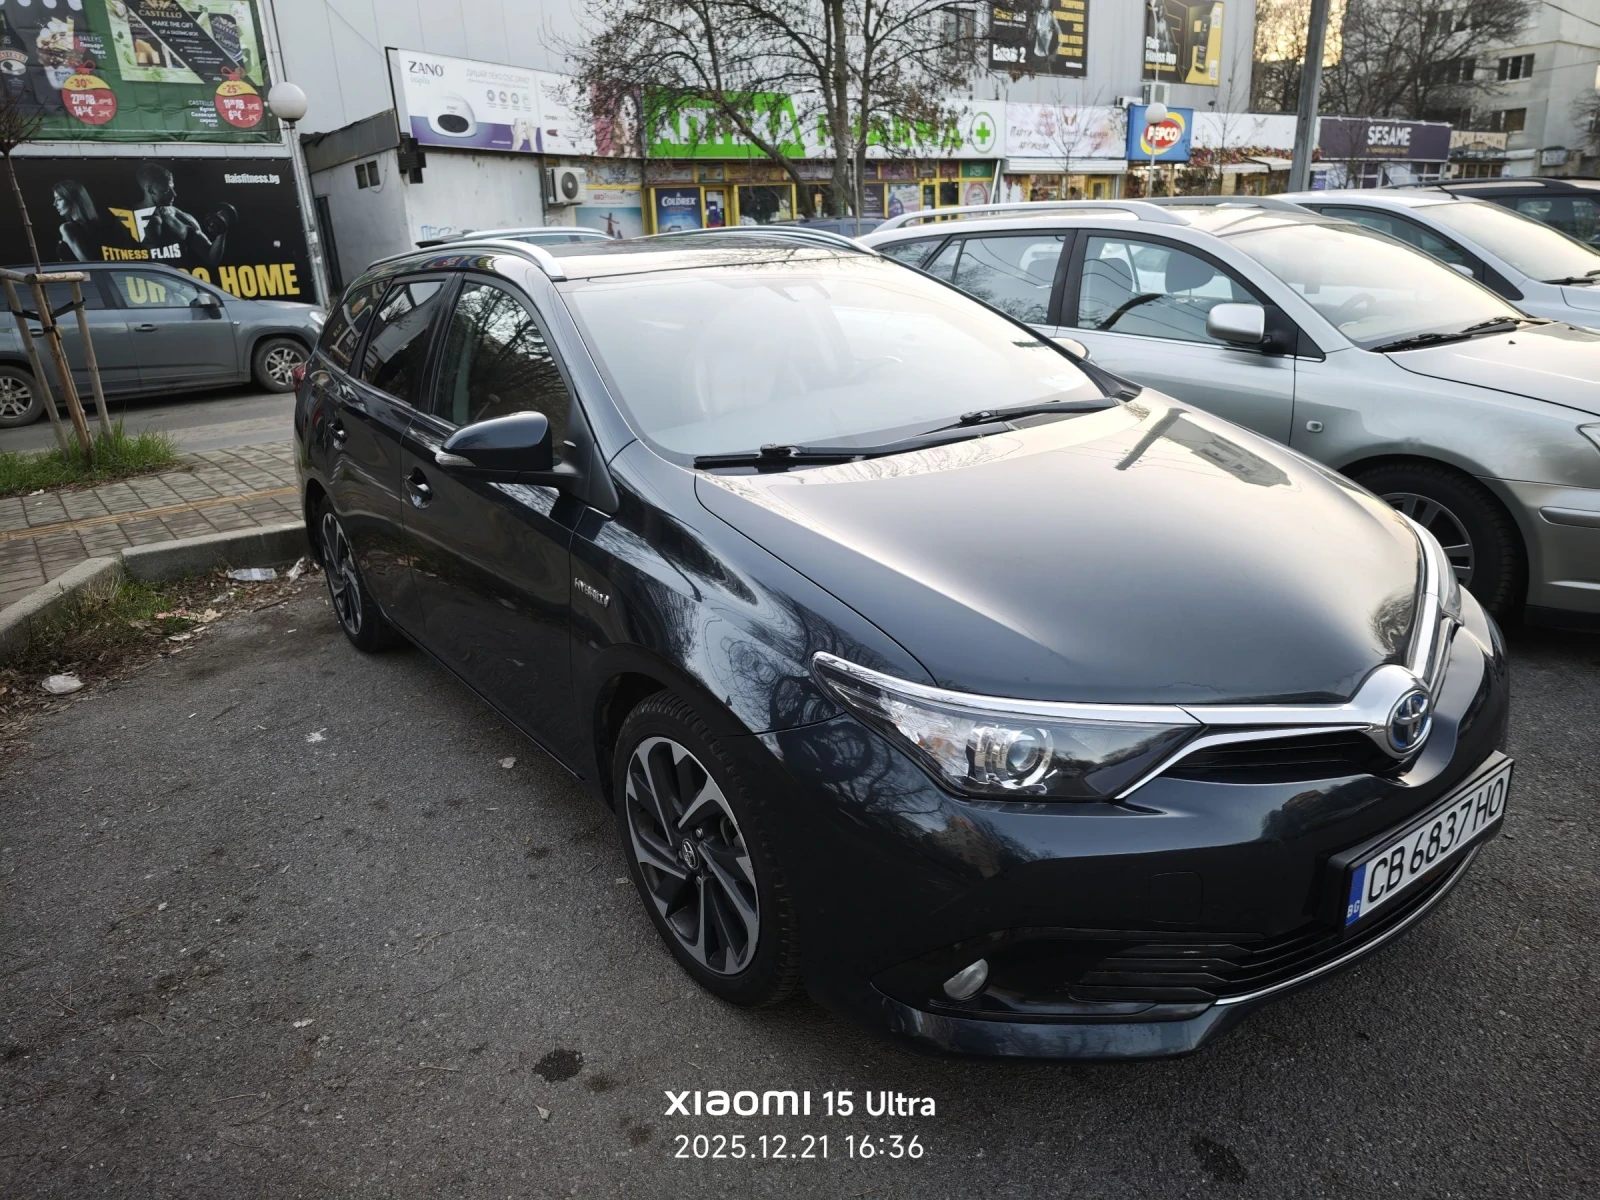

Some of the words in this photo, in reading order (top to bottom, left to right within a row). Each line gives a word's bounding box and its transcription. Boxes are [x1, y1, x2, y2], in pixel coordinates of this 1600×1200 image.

[139, 10, 182, 19] CASTELLO
[1019, 46, 1026, 63] 2
[408, 60, 445, 77] ZANO
[1147, 126, 1178, 141] PEPCO
[1367, 126, 1412, 146] SESAME
[661, 196, 697, 207] COLDREX
[102, 246, 149, 261] FITNESS
[151, 243, 181, 259] FLAIS
[218, 263, 300, 298] HOME
[1410, 797, 1474, 875] 6837
[1346, 900, 1361, 919] BG
